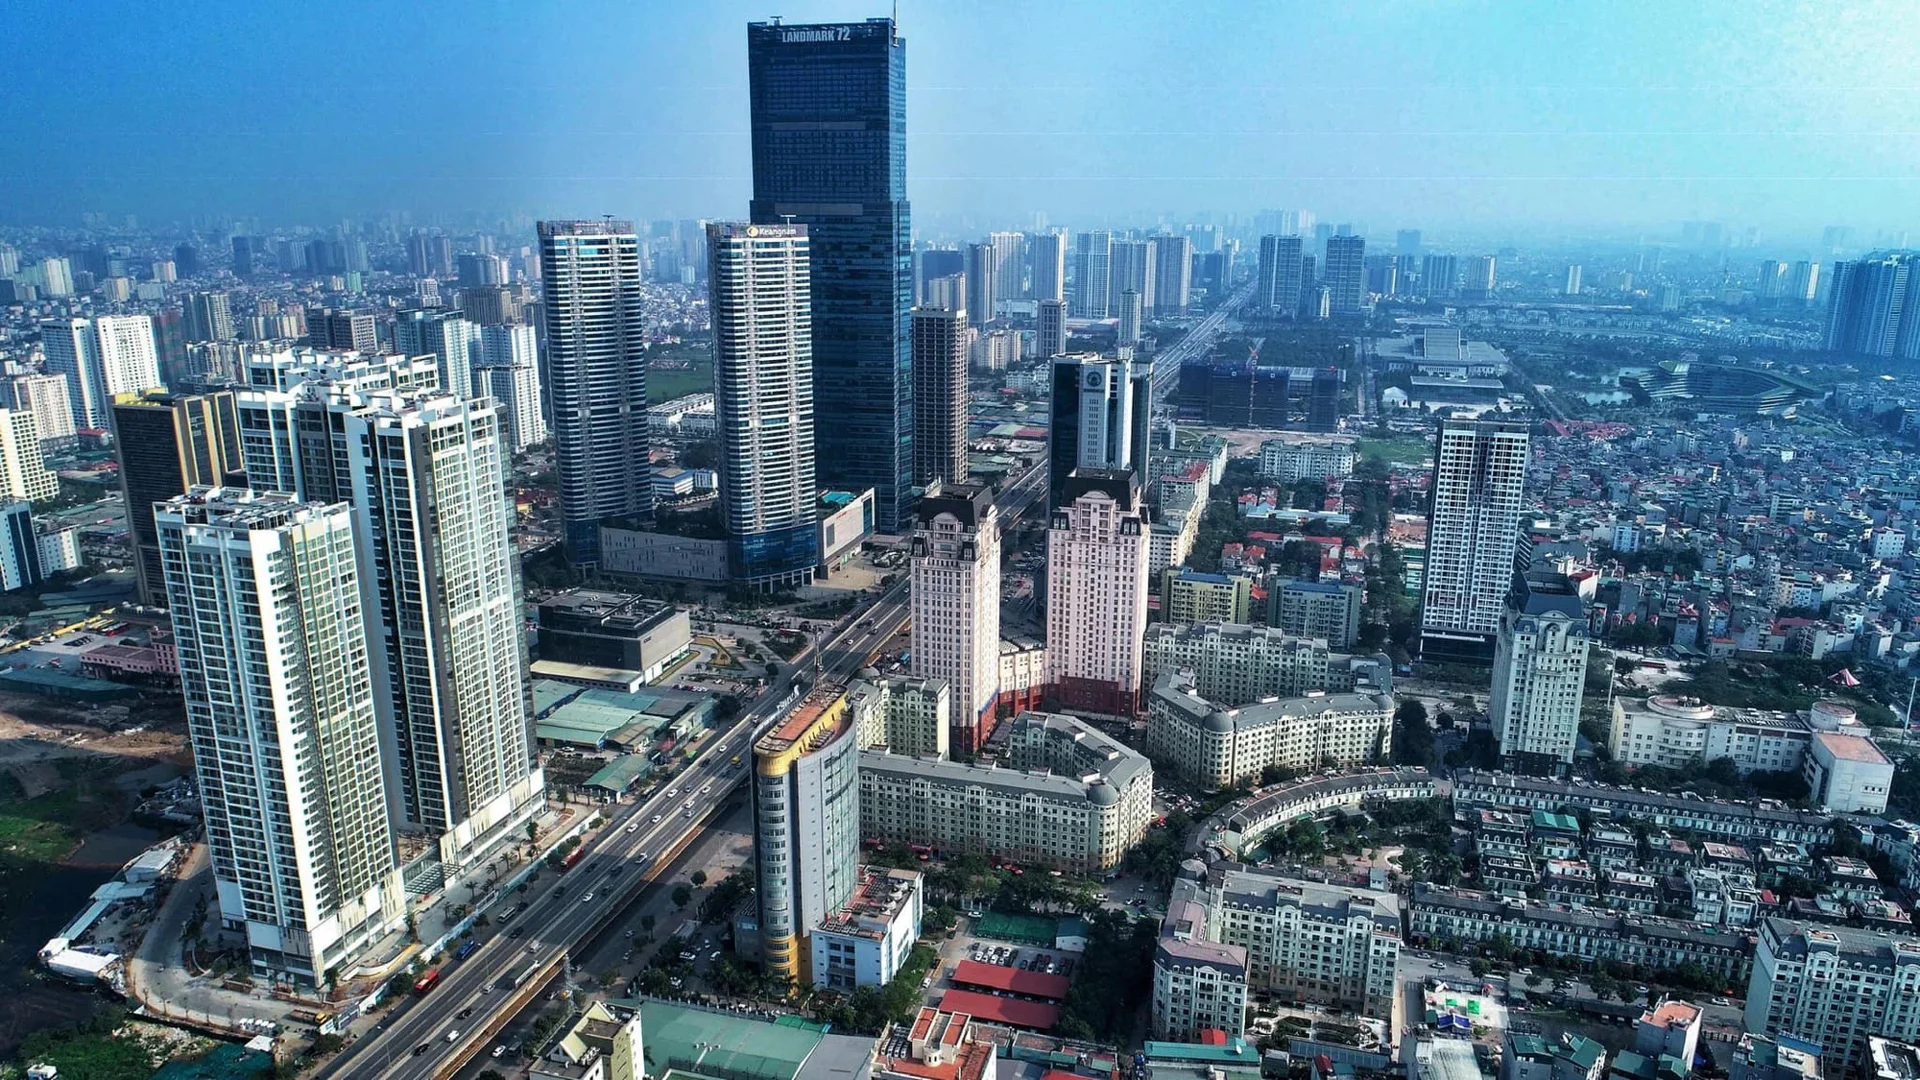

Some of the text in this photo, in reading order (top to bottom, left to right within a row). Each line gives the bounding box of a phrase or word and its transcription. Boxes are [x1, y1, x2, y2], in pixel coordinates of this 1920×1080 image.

[782, 25, 851, 43] LANDMARK 72
[759, 227, 797, 237] Keangnam
